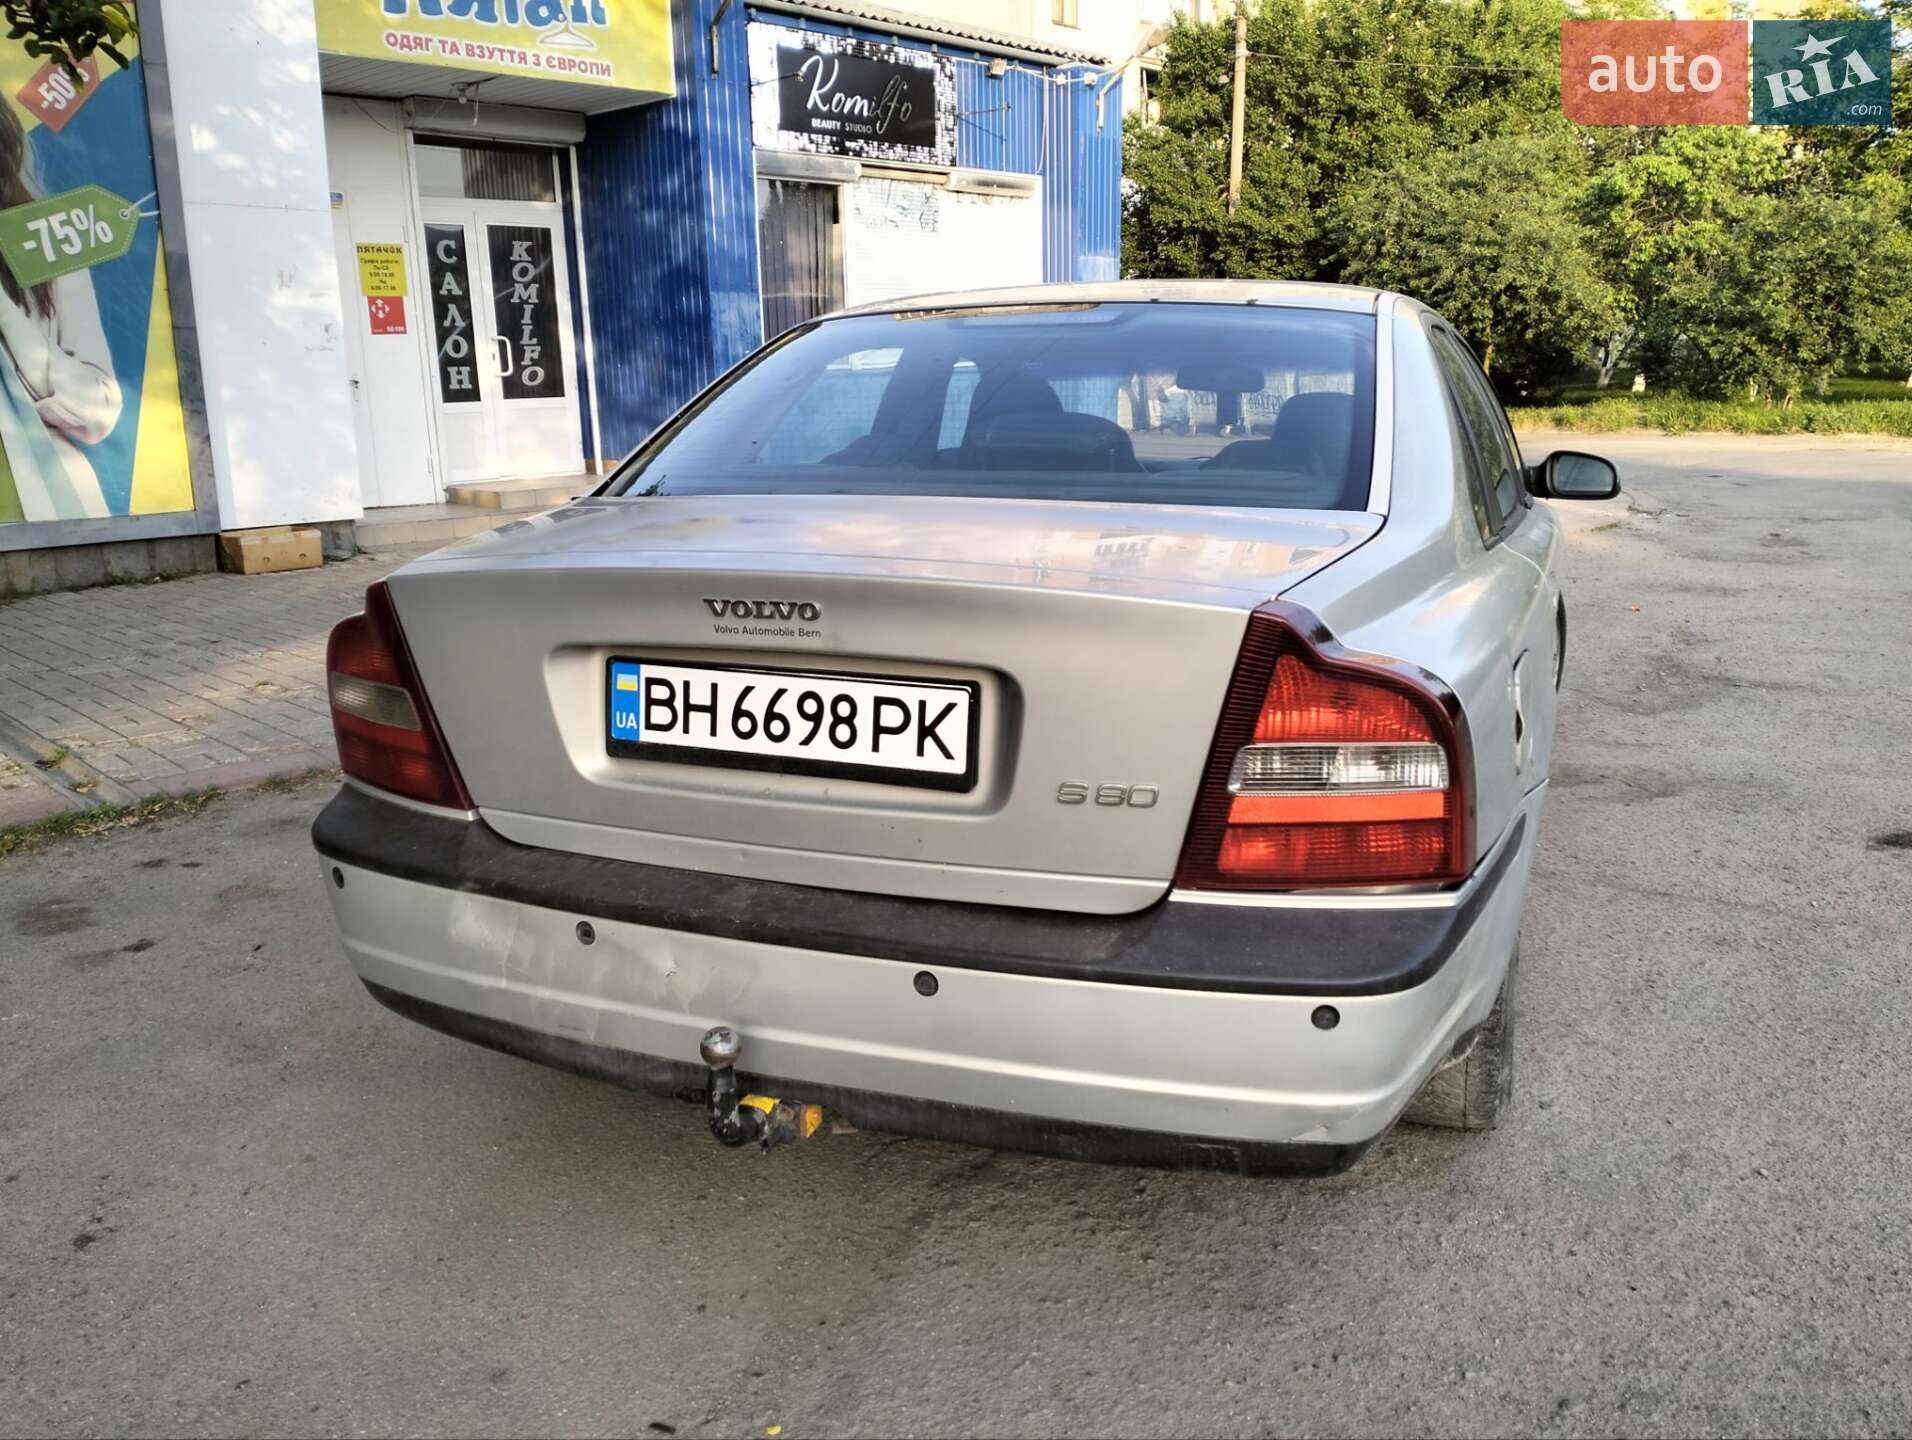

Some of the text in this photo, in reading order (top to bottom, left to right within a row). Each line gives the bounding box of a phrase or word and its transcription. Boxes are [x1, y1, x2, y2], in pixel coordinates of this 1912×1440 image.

[385, 32, 611, 77] ОДЯГ ТА ВЗУТТЯ З ЄВРОПИ
[811, 118, 872, 134] BEAUTY STUDIO
[22, 204, 113, 262] -75%
[436, 240, 472, 389] САЛОН
[510, 241, 544, 386] KOMILFO
[703, 598, 821, 621] VOLVO
[714, 624, 821, 637] Volvo Automobile Bern
[615, 711, 637, 729] UA
[731, 685, 858, 750] 6698
